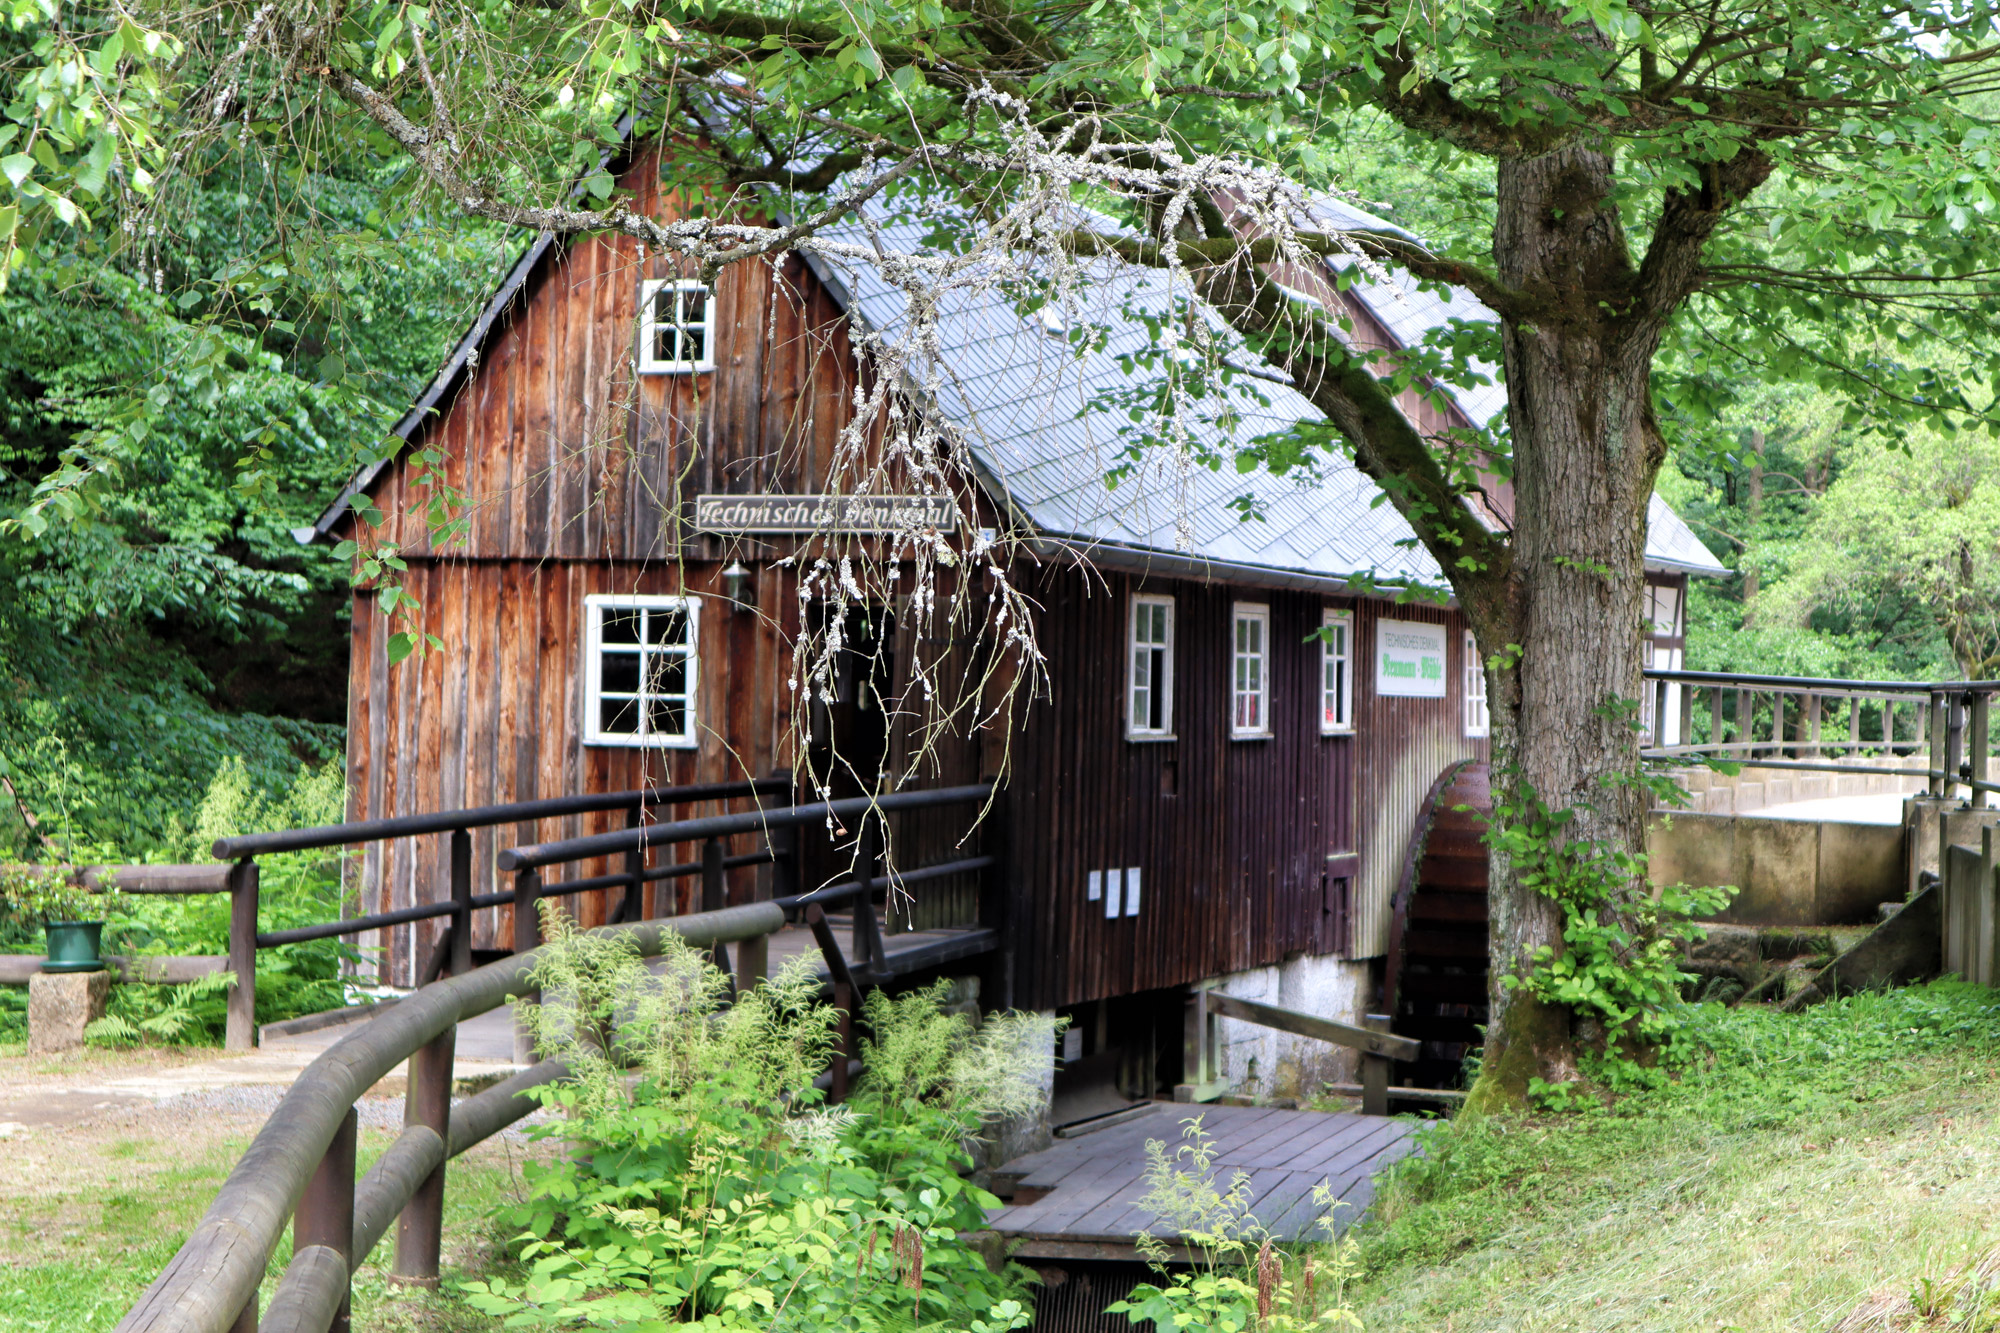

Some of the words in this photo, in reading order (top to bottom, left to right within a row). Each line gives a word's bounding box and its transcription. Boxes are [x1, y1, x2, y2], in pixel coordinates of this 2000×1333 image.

[700, 500, 835, 523] Technisches
[840, 500, 951, 524] Denkal
[1384, 632, 1418, 650] TECHNISCHES
[1419, 635, 1440, 652] DENKMAL
